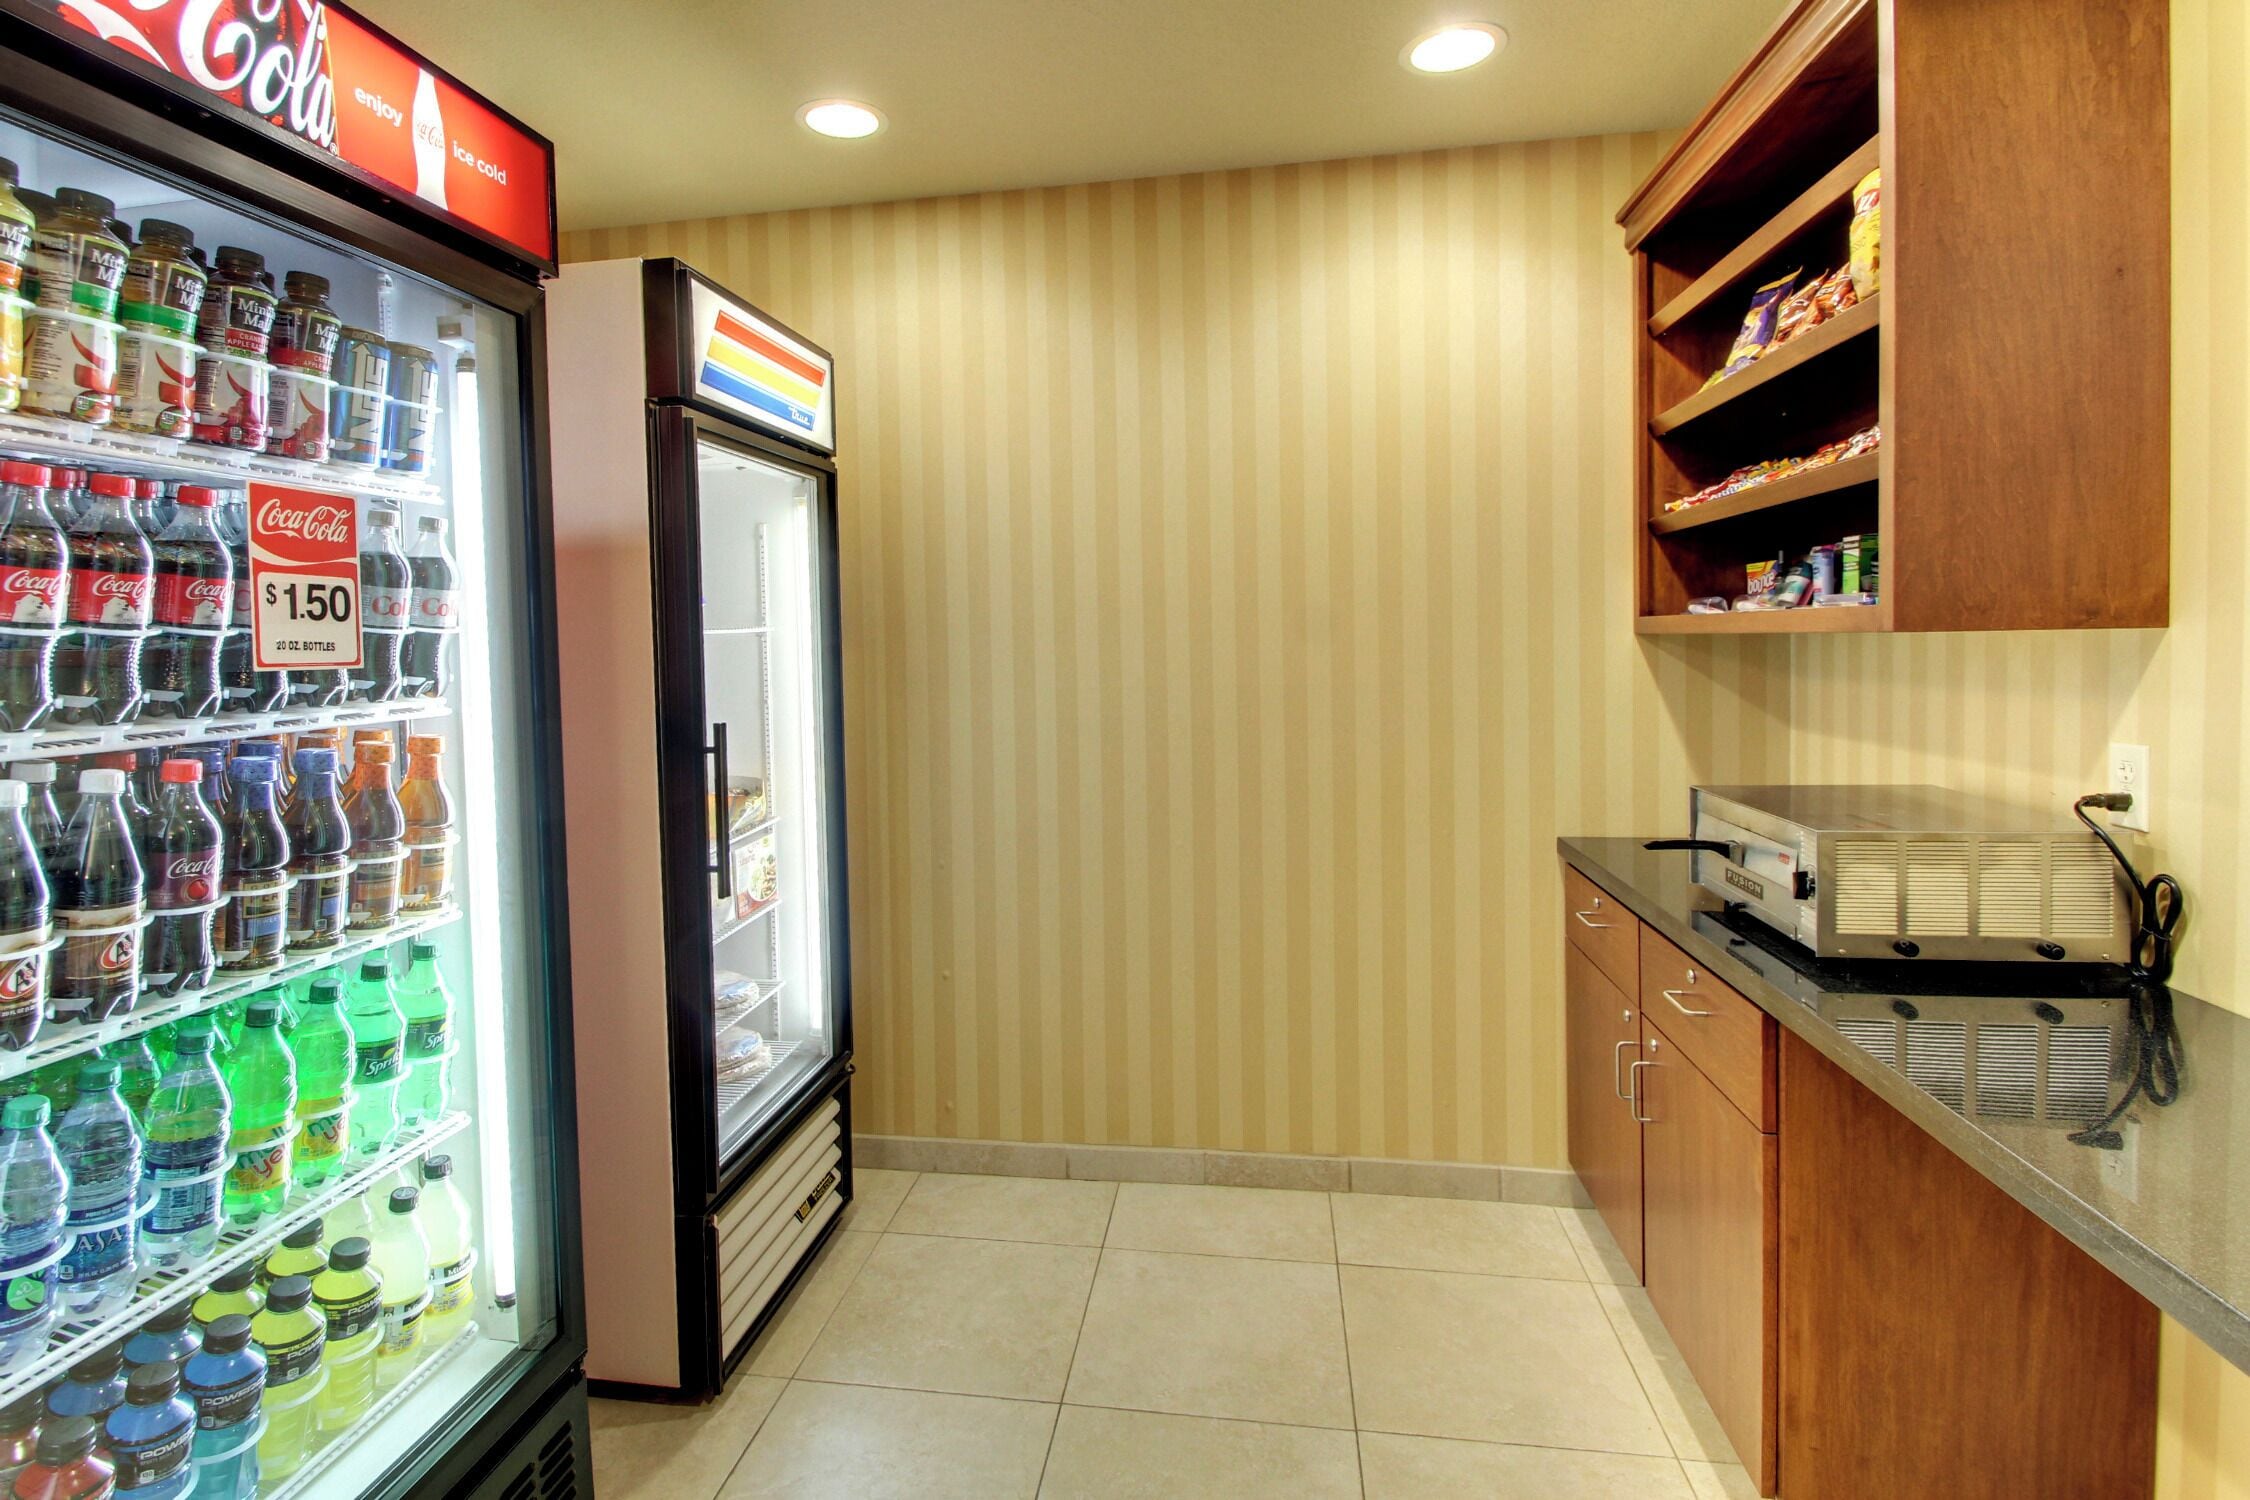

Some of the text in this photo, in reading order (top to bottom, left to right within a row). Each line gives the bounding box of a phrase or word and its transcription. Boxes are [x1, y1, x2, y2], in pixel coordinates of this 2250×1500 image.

[354, 87, 403, 127] enjoy
[453, 140, 507, 186] ice cold
[257, 499, 352, 543] Coca-Cola
[4, 569, 72, 596] Coca-C
[92, 574, 157, 599] Coca-C
[185, 579, 235, 601] Coca-C
[276, 640, 287, 651] 20
[303, 641, 336, 652] BOTTLES
[1727, 870, 1762, 893] FUSION
